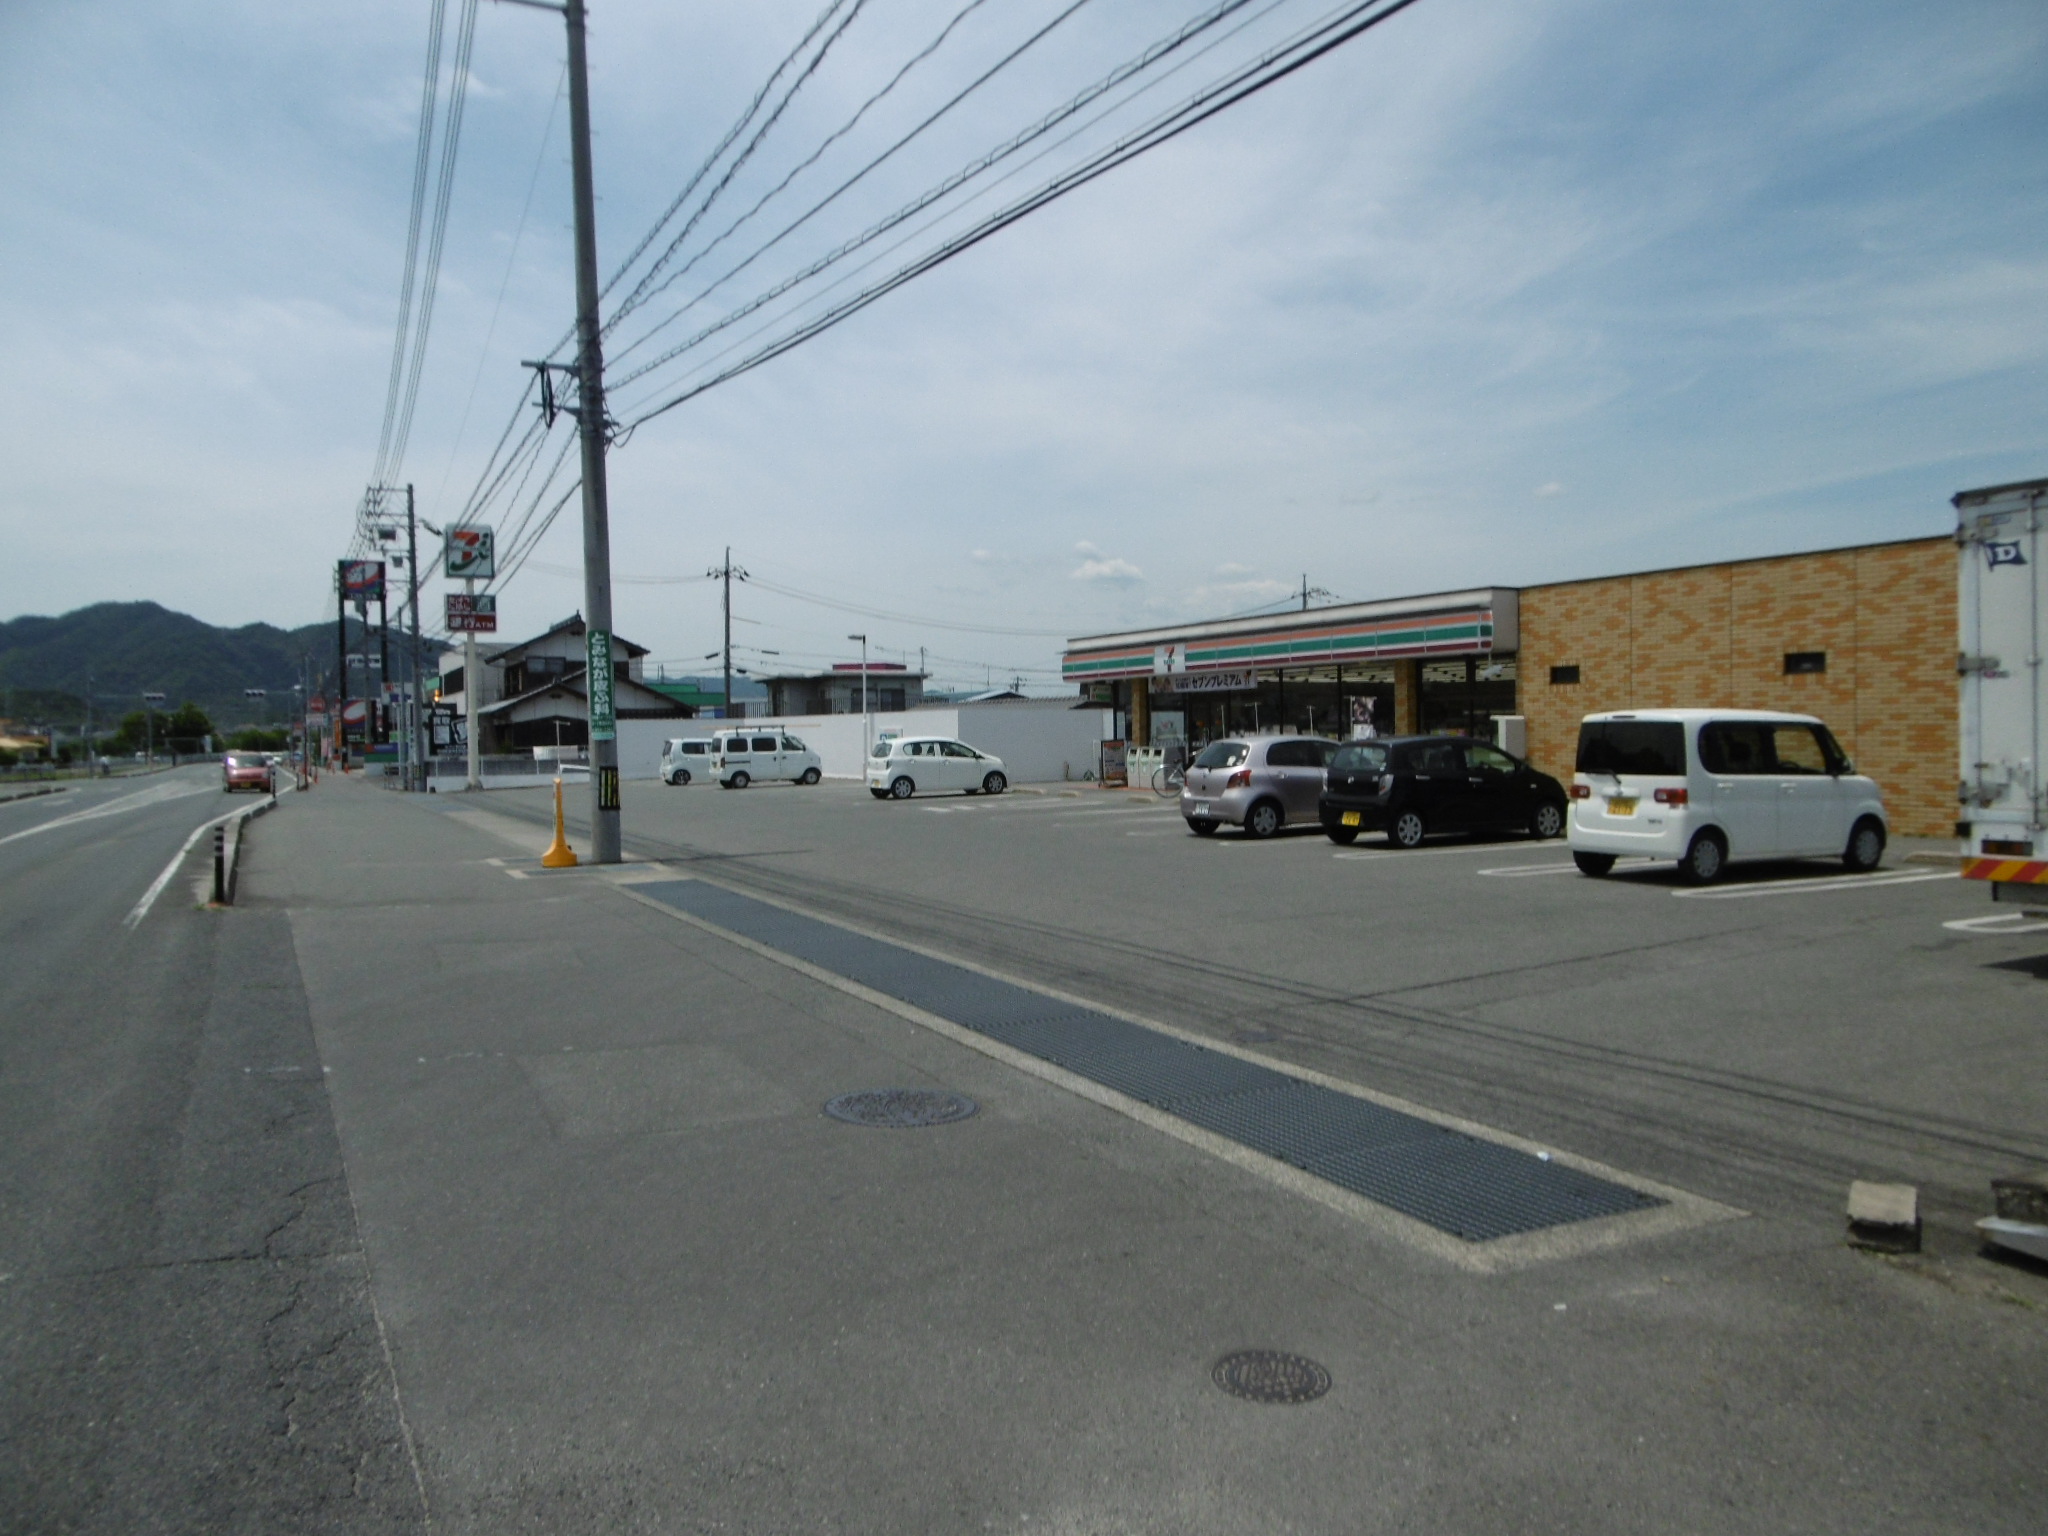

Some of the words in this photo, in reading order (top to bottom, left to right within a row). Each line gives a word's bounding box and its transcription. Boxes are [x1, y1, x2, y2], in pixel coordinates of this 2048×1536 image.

[1995, 545, 2017, 562] D
[591, 631, 610, 715] とみなが皮ふ科
[1192, 673, 1242, 689] セブンプレミアム
